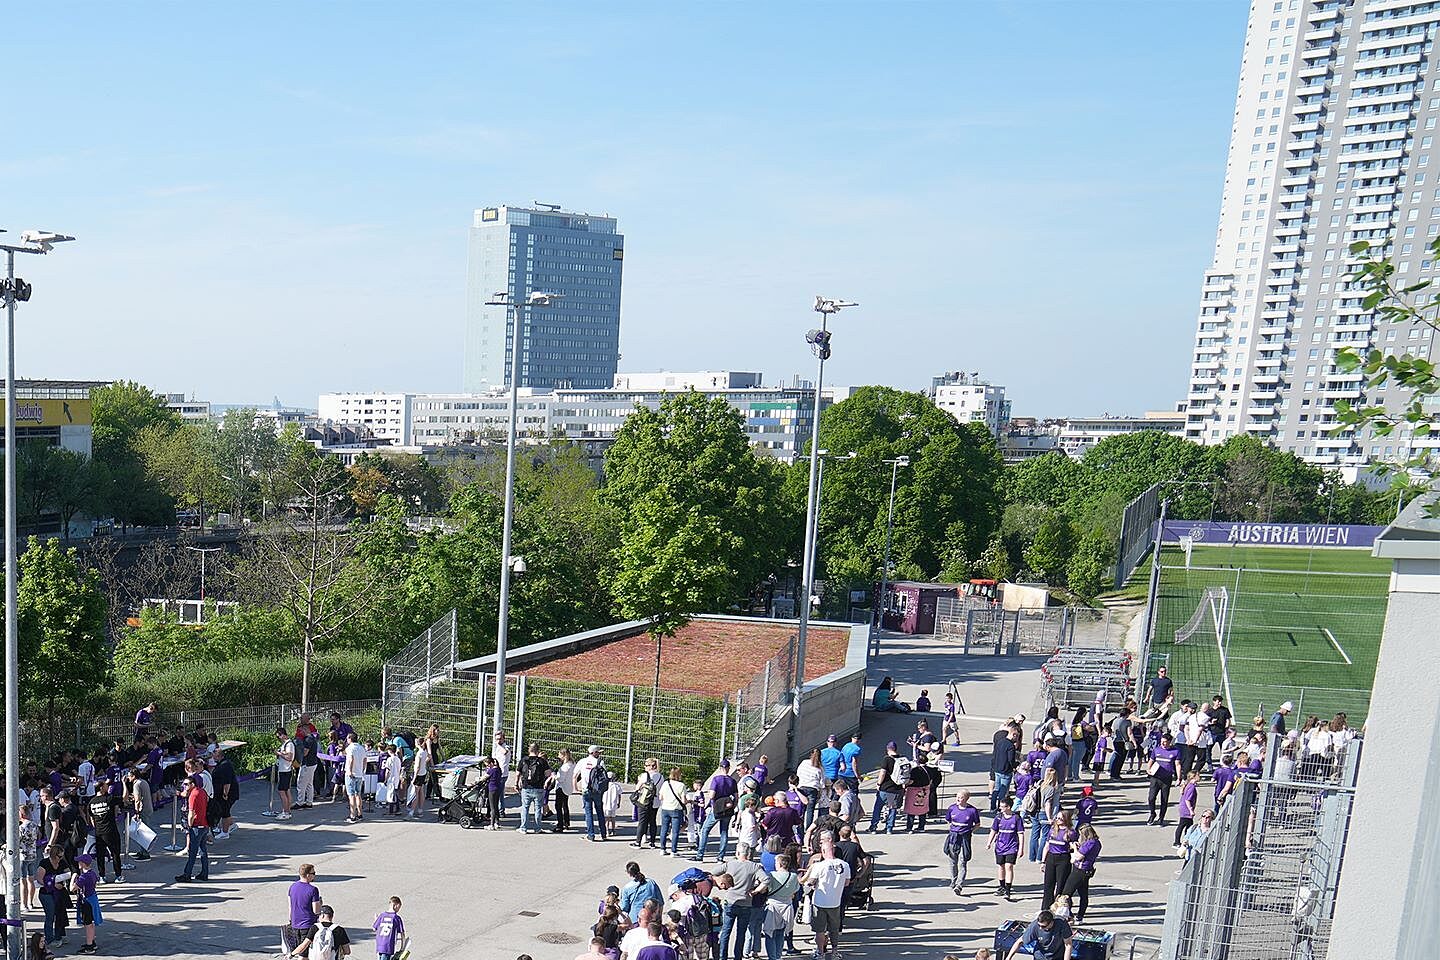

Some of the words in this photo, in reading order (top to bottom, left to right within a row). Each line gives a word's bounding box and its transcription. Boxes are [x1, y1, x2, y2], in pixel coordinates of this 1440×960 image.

[15, 402, 43, 425] Ludwig
[1227, 524, 1300, 543] AUSTRIA
[1304, 526, 1350, 545] WIEN
[1083, 804, 1092, 815] 6
